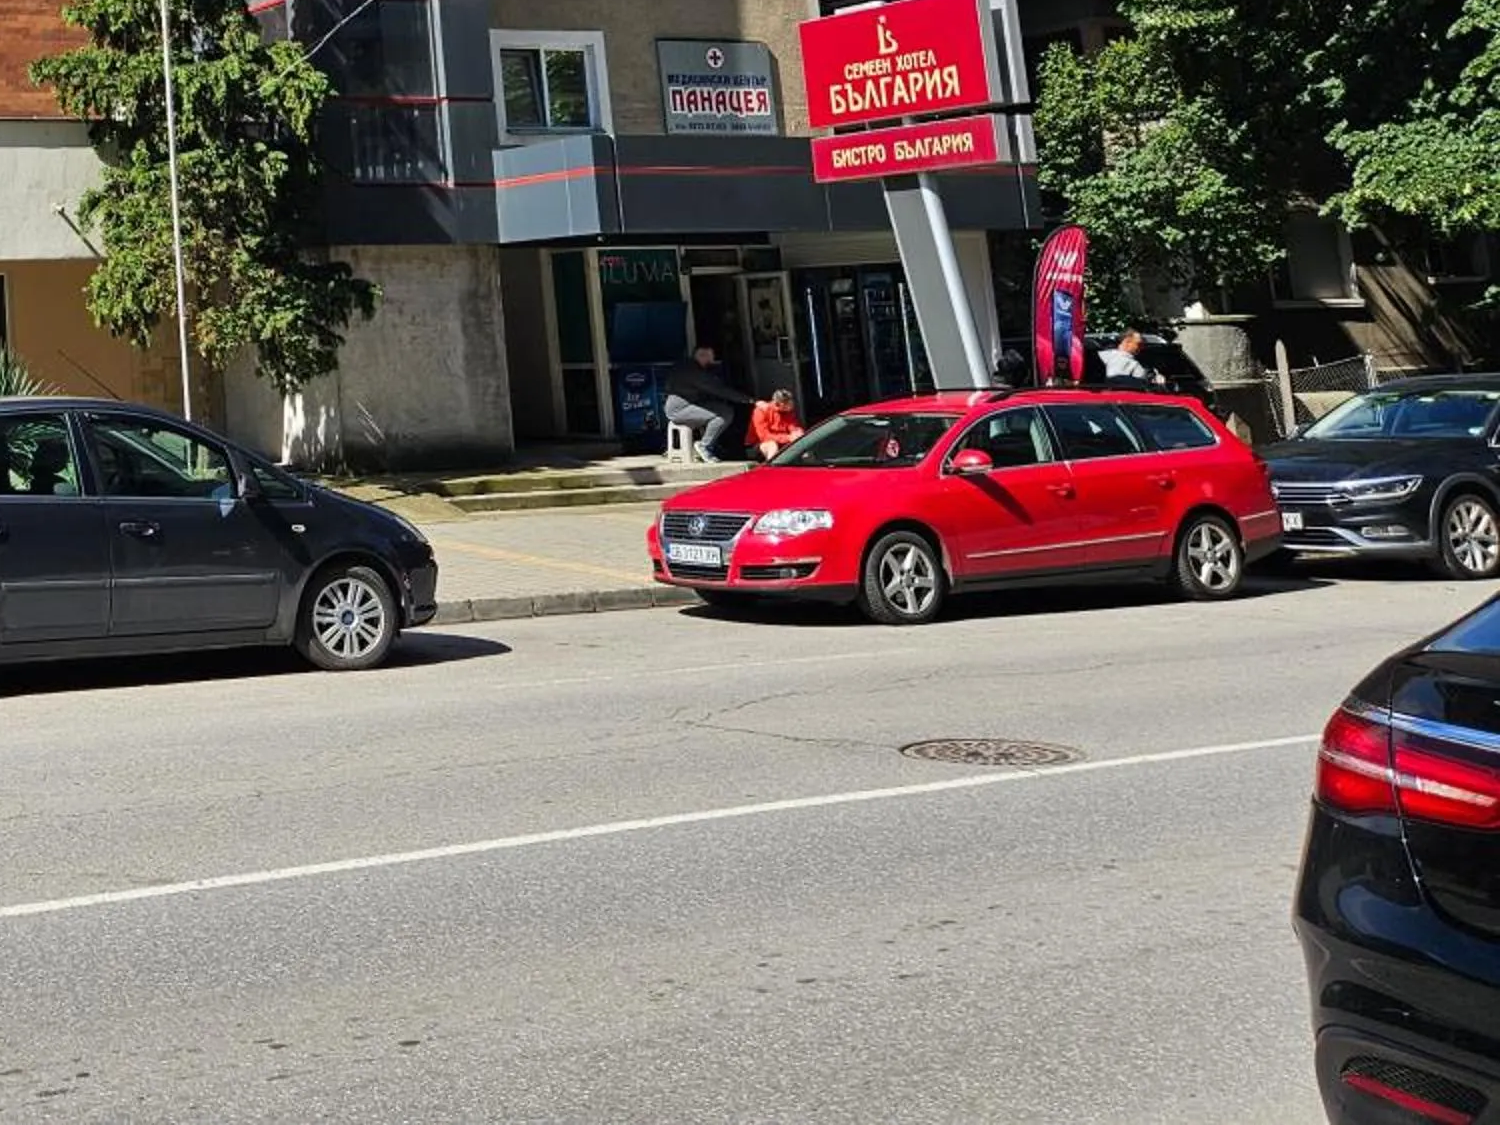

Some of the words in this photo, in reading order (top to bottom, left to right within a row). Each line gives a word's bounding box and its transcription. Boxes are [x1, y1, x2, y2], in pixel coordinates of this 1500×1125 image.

[844, 57, 892, 80] СЕМЕЕН
[895, 49, 937, 71] ХОТЕЛ
[670, 87, 770, 116] ПАНАЦЕЯ
[829, 65, 961, 115] БЪЛГАРИЯ
[831, 144, 887, 169] БИСТРО
[893, 132, 974, 161] БЪЛГАРИЯ
